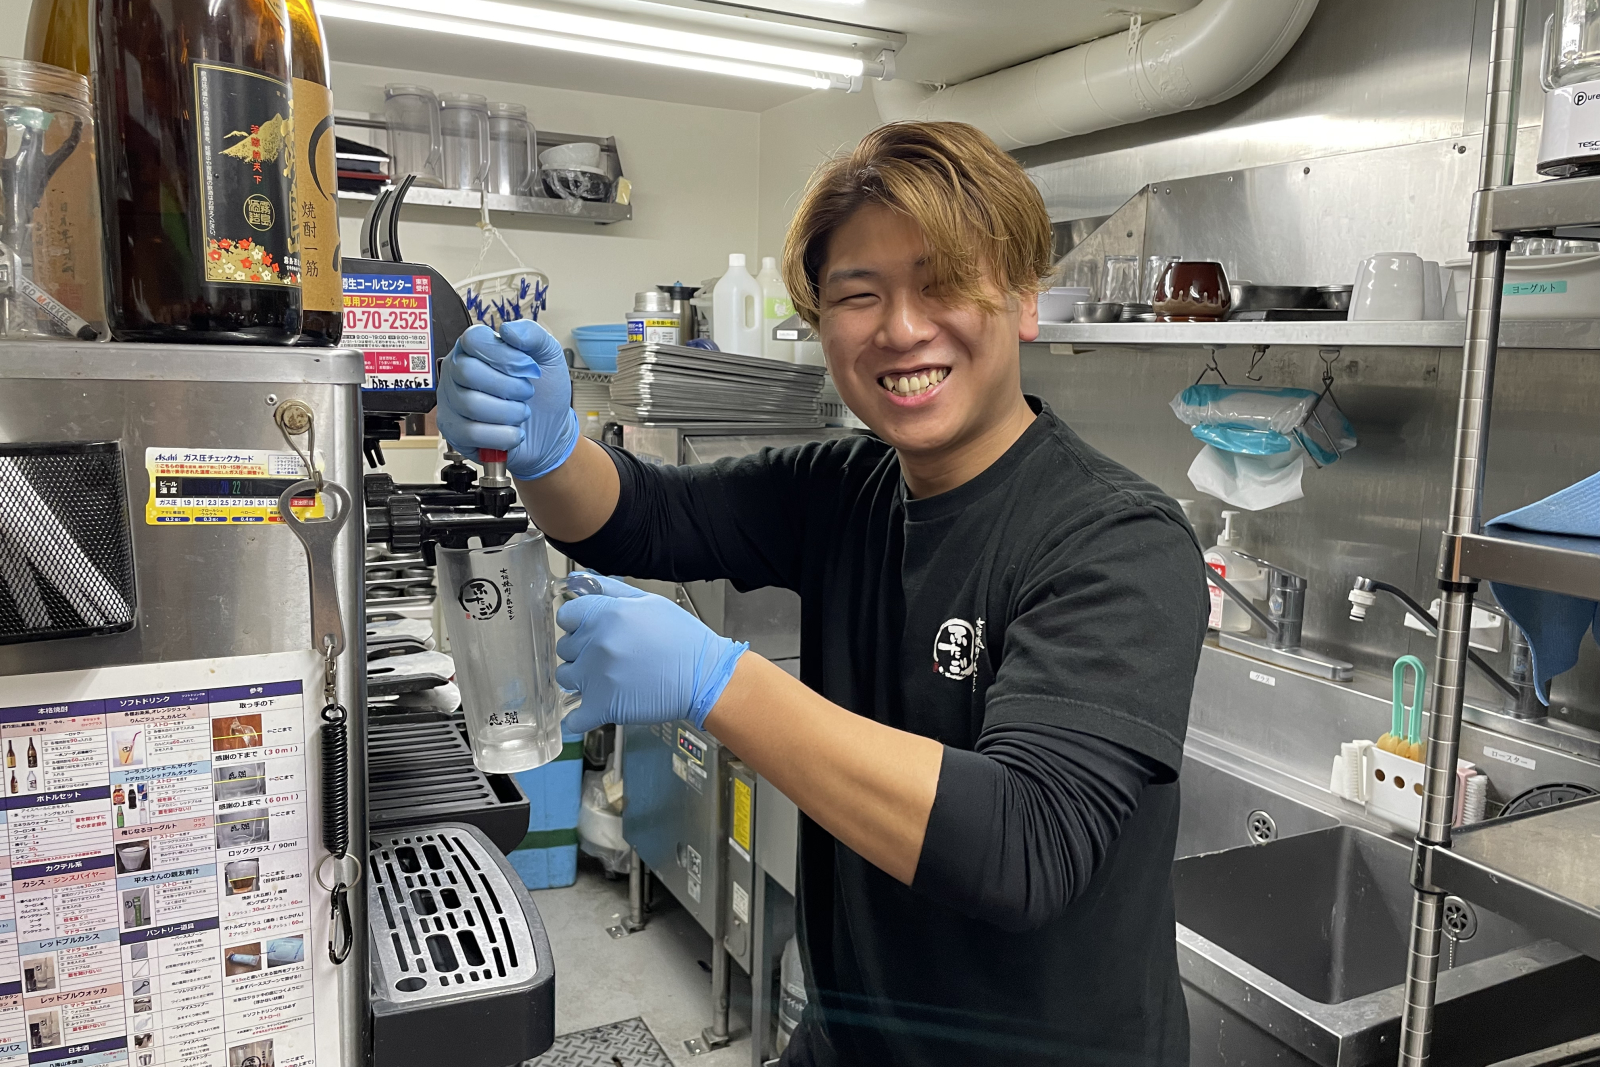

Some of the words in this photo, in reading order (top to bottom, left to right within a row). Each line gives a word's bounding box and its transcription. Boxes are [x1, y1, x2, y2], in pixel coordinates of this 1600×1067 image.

[301, 200, 319, 278] 焼酎一筋
[1512, 283, 1556, 294] ヨーグルト
[36, 295, 74, 324] MARKER
[343, 310, 428, 330] 0-70-2525
[155, 453, 178, 462] Asahi
[184, 454, 254, 463] ガス圧チェックカード
[220, 481, 229, 494] 20
[232, 481, 241, 495] 22
[119, 696, 170, 707] ソフトドリンク
[239, 699, 275, 709] 取っ手の下
[1491, 750, 1528, 765] ロースター
[36, 791, 82, 803] ボトルセット
[228, 845, 271, 857] ロックグラス
[278, 841, 298, 849] 90ml
[45, 861, 83, 873] カクテル系
[39, 933, 100, 949] レッドブルカシス
[40, 987, 108, 1004] レッドブルウォッカ
[68, 1044, 90, 1054] 日本酒
